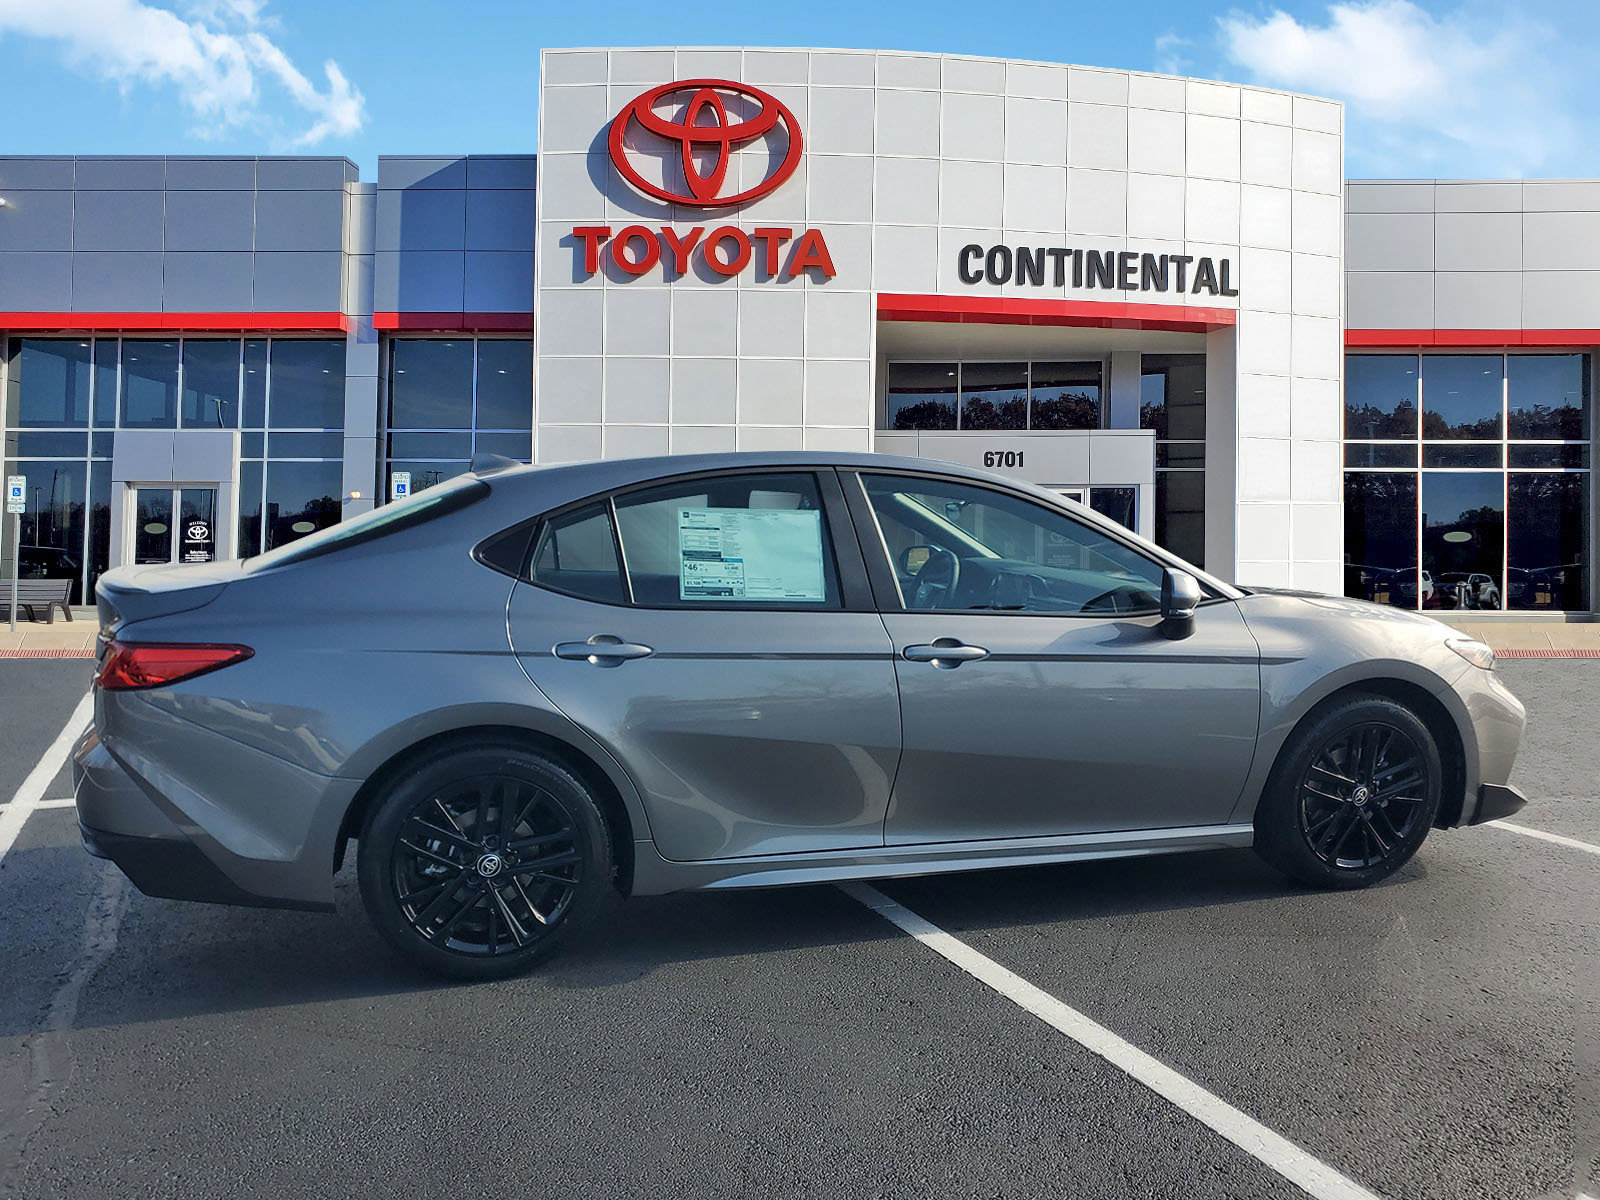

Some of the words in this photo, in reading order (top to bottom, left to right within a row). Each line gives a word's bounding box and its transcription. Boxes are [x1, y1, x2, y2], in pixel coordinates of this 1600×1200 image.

[572, 225, 837, 278] TOYOTA
[957, 244, 1239, 297] CONTINENTAL
[983, 451, 1024, 468] 6701
